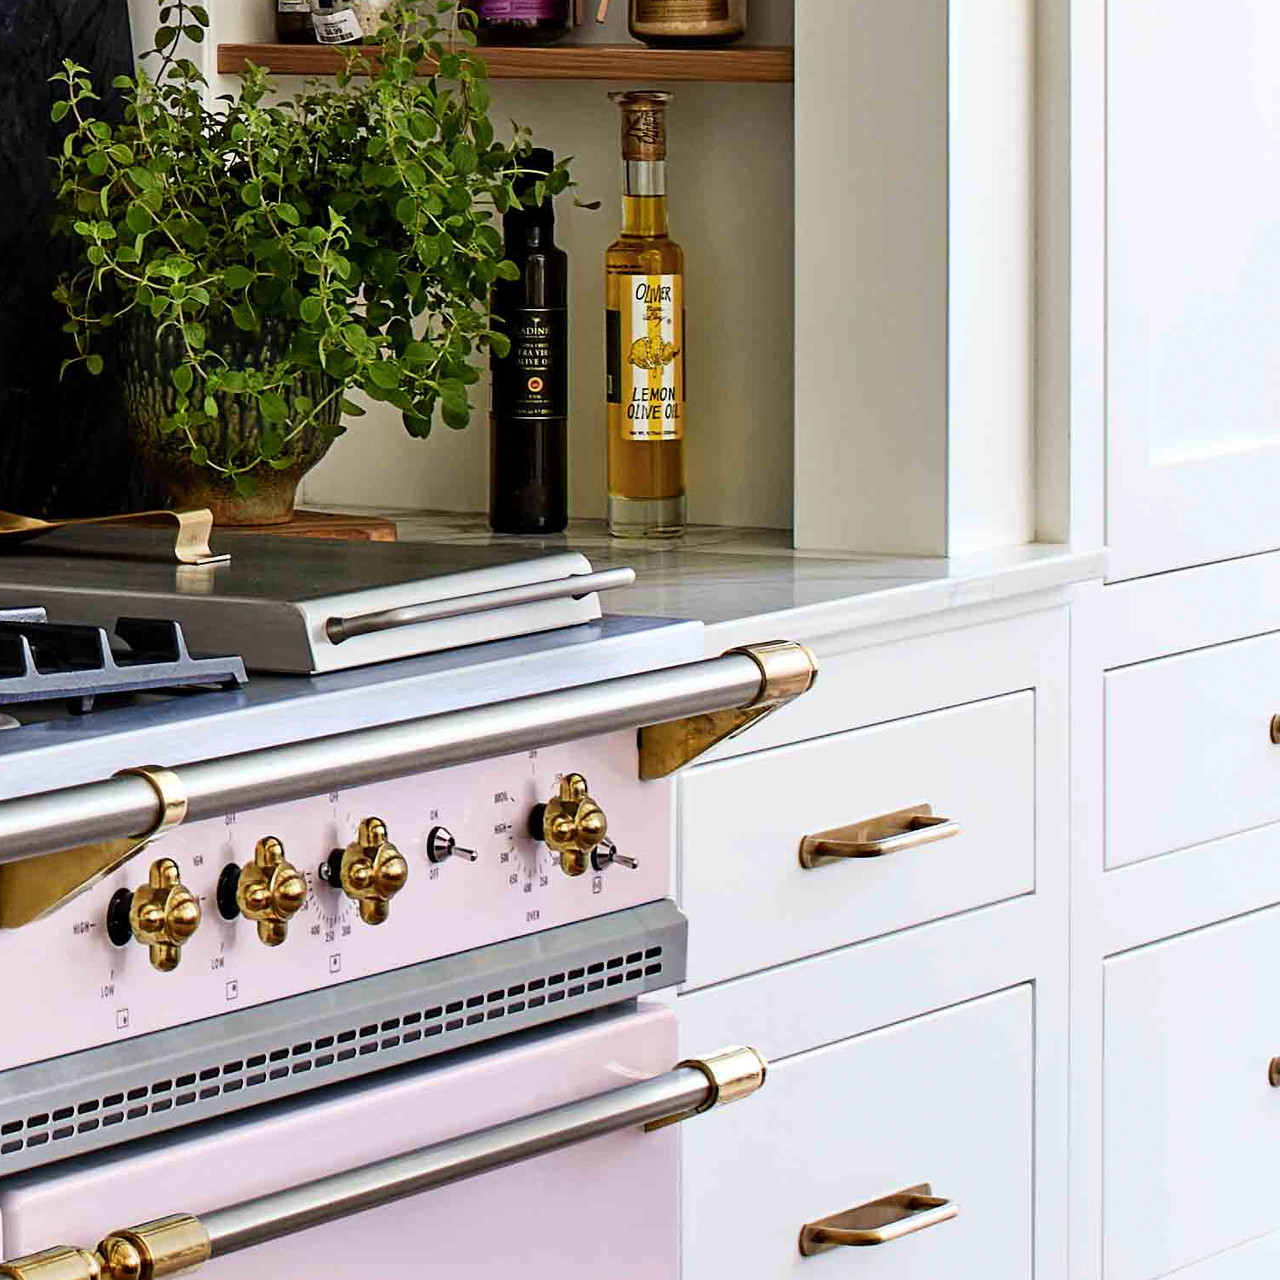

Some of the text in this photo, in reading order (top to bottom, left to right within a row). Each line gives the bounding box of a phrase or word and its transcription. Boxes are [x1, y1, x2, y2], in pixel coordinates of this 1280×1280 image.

[635, 283, 671, 304] OLIVIER
[632, 387, 675, 402] LEMON
[627, 402, 680, 420] OLIVE OIL
[212, 957, 224, 969] LOW
[101, 985, 114, 998] LOW
